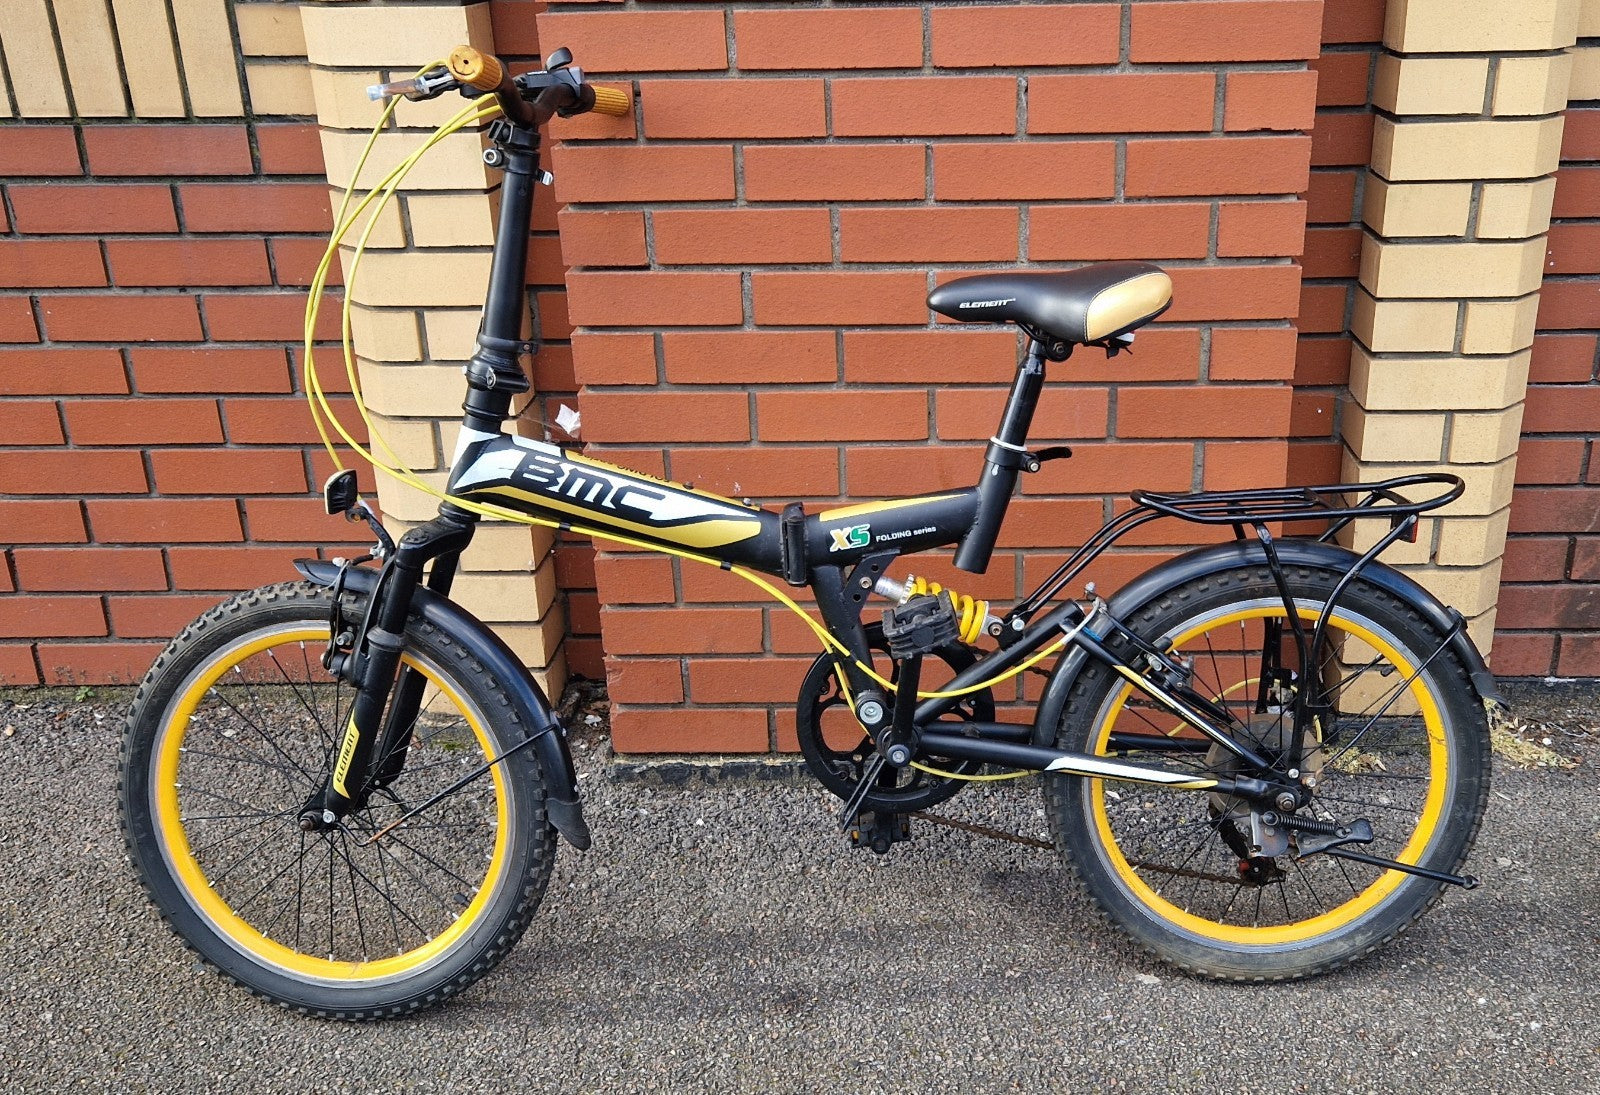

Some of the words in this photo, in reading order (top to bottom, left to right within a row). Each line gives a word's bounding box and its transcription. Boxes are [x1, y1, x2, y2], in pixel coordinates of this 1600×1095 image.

[959, 298, 1016, 308] ELEMENT
[511, 450, 666, 520] BMC
[876, 530, 912, 542] FOLDING
[913, 526, 937, 535] series
[336, 731, 355, 783] ELEMENT
